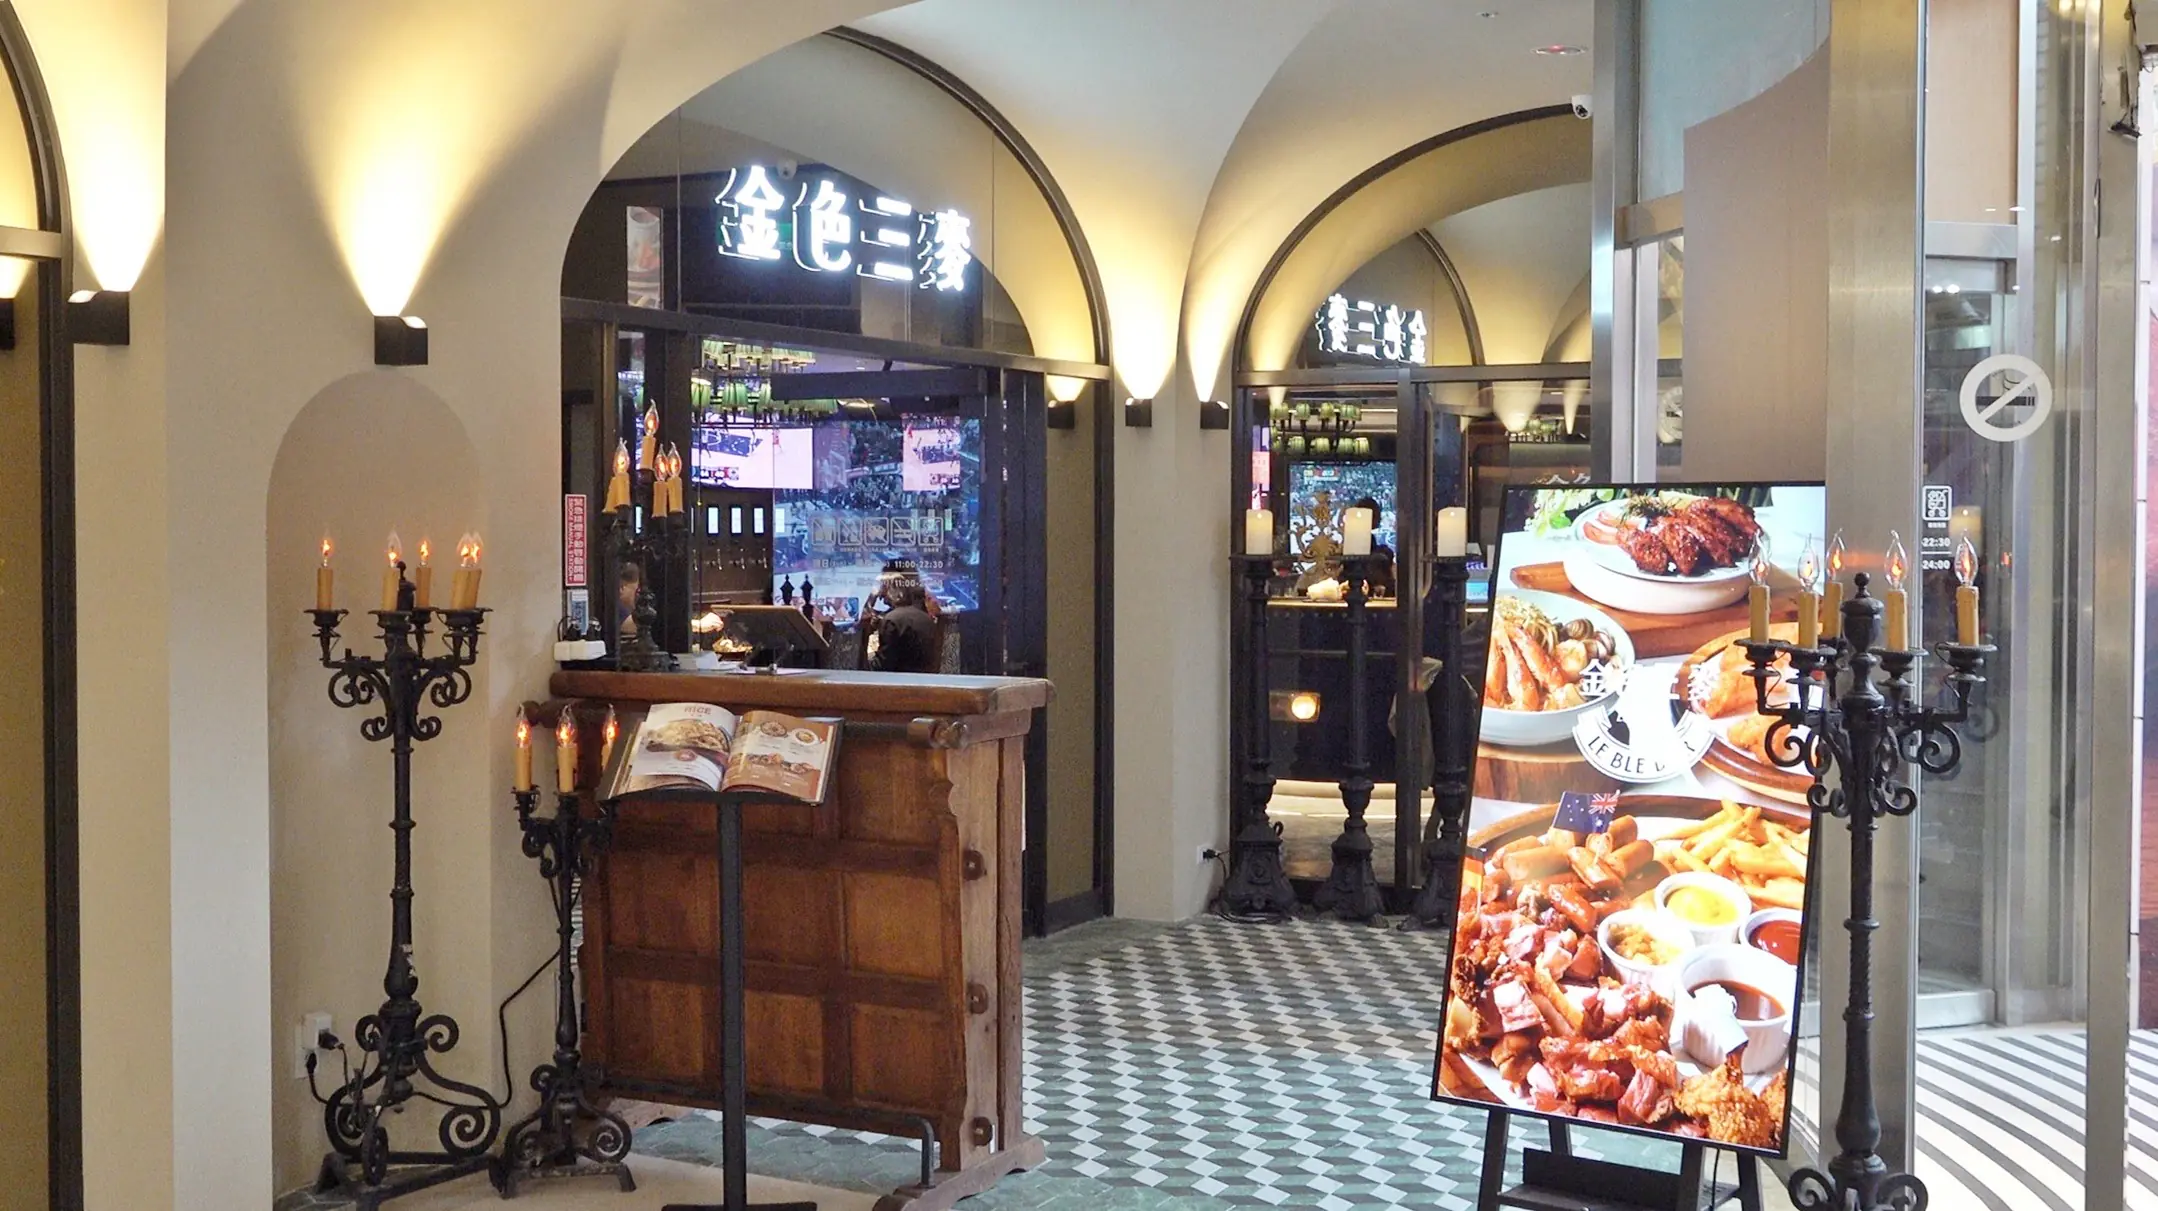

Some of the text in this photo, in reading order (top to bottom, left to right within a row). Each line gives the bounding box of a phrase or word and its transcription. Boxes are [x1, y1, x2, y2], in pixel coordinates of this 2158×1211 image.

[715, 164, 971, 291] 金色三麥
[1610, 752, 1645, 774] BLE
